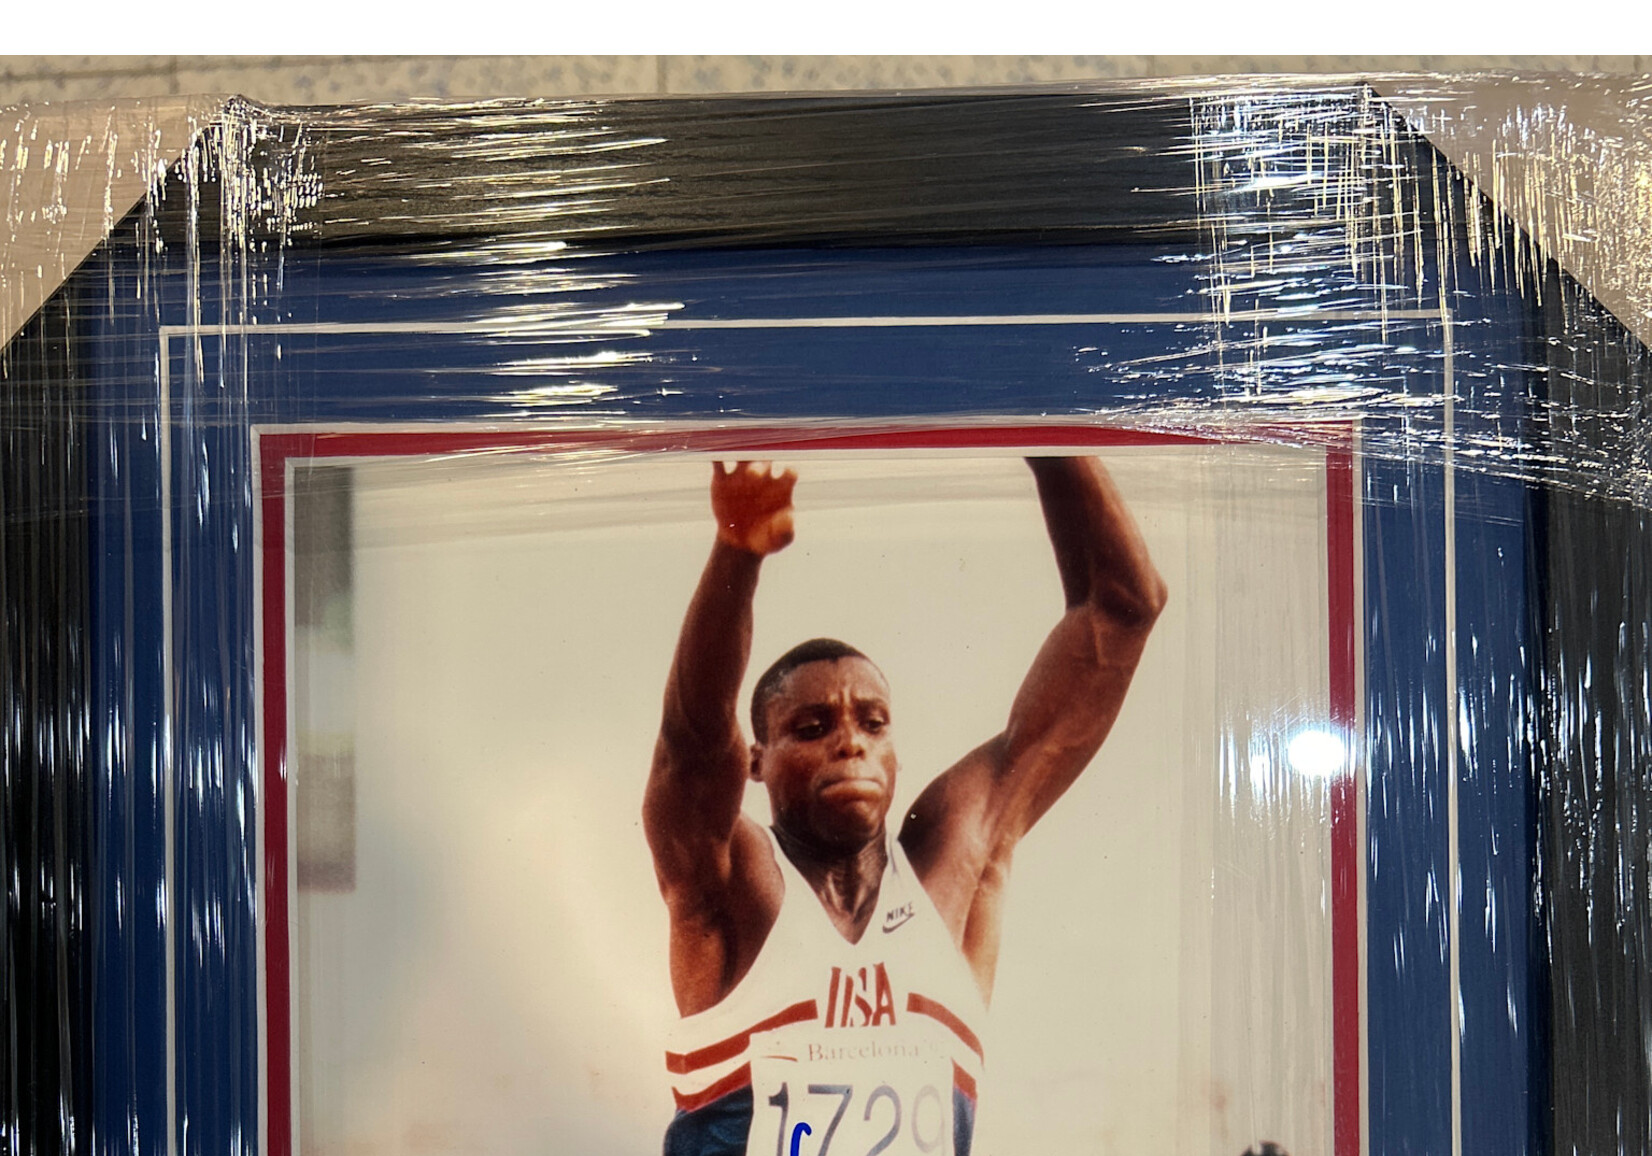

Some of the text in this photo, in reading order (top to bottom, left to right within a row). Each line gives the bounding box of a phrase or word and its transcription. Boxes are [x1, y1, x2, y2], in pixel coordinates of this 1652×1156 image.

[886, 902, 914, 922] NIKE
[825, 962, 896, 1028] USA
[808, 1041, 920, 1061] Barcelona
